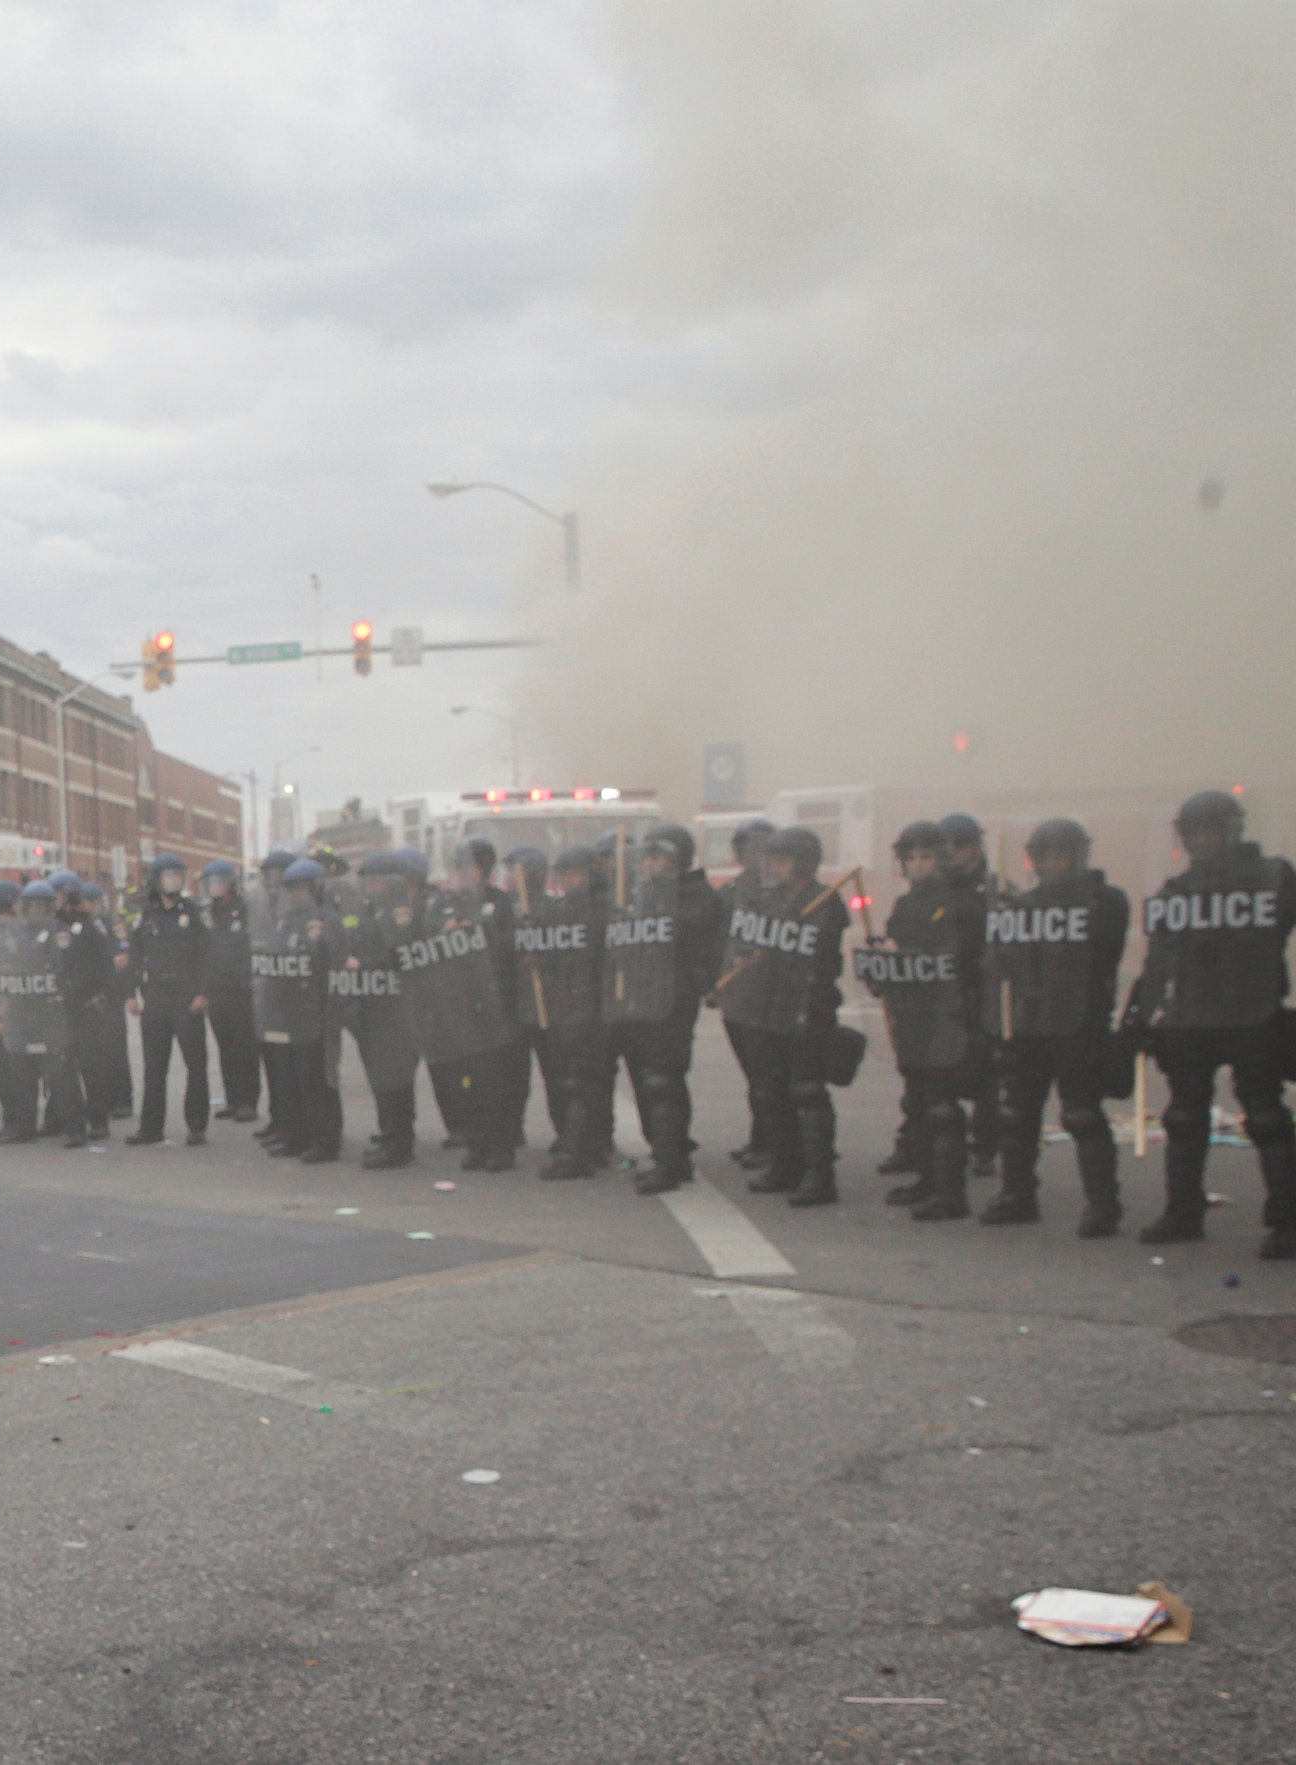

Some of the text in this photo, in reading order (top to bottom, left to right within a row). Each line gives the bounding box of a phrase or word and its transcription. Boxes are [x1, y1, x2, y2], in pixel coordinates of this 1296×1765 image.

[986, 906, 1090, 944] POLICE
[1146, 891, 1278, 933] POLICE
[513, 924, 588, 952] POLICE
[605, 917, 674, 949] POLICE
[729, 906, 821, 956] POLICE
[396, 925, 488, 971] POLICE
[251, 954, 312, 977] POLICE
[854, 949, 958, 984] POLICE
[0, 973, 58, 994] POLICE
[328, 970, 403, 996] POLICE
